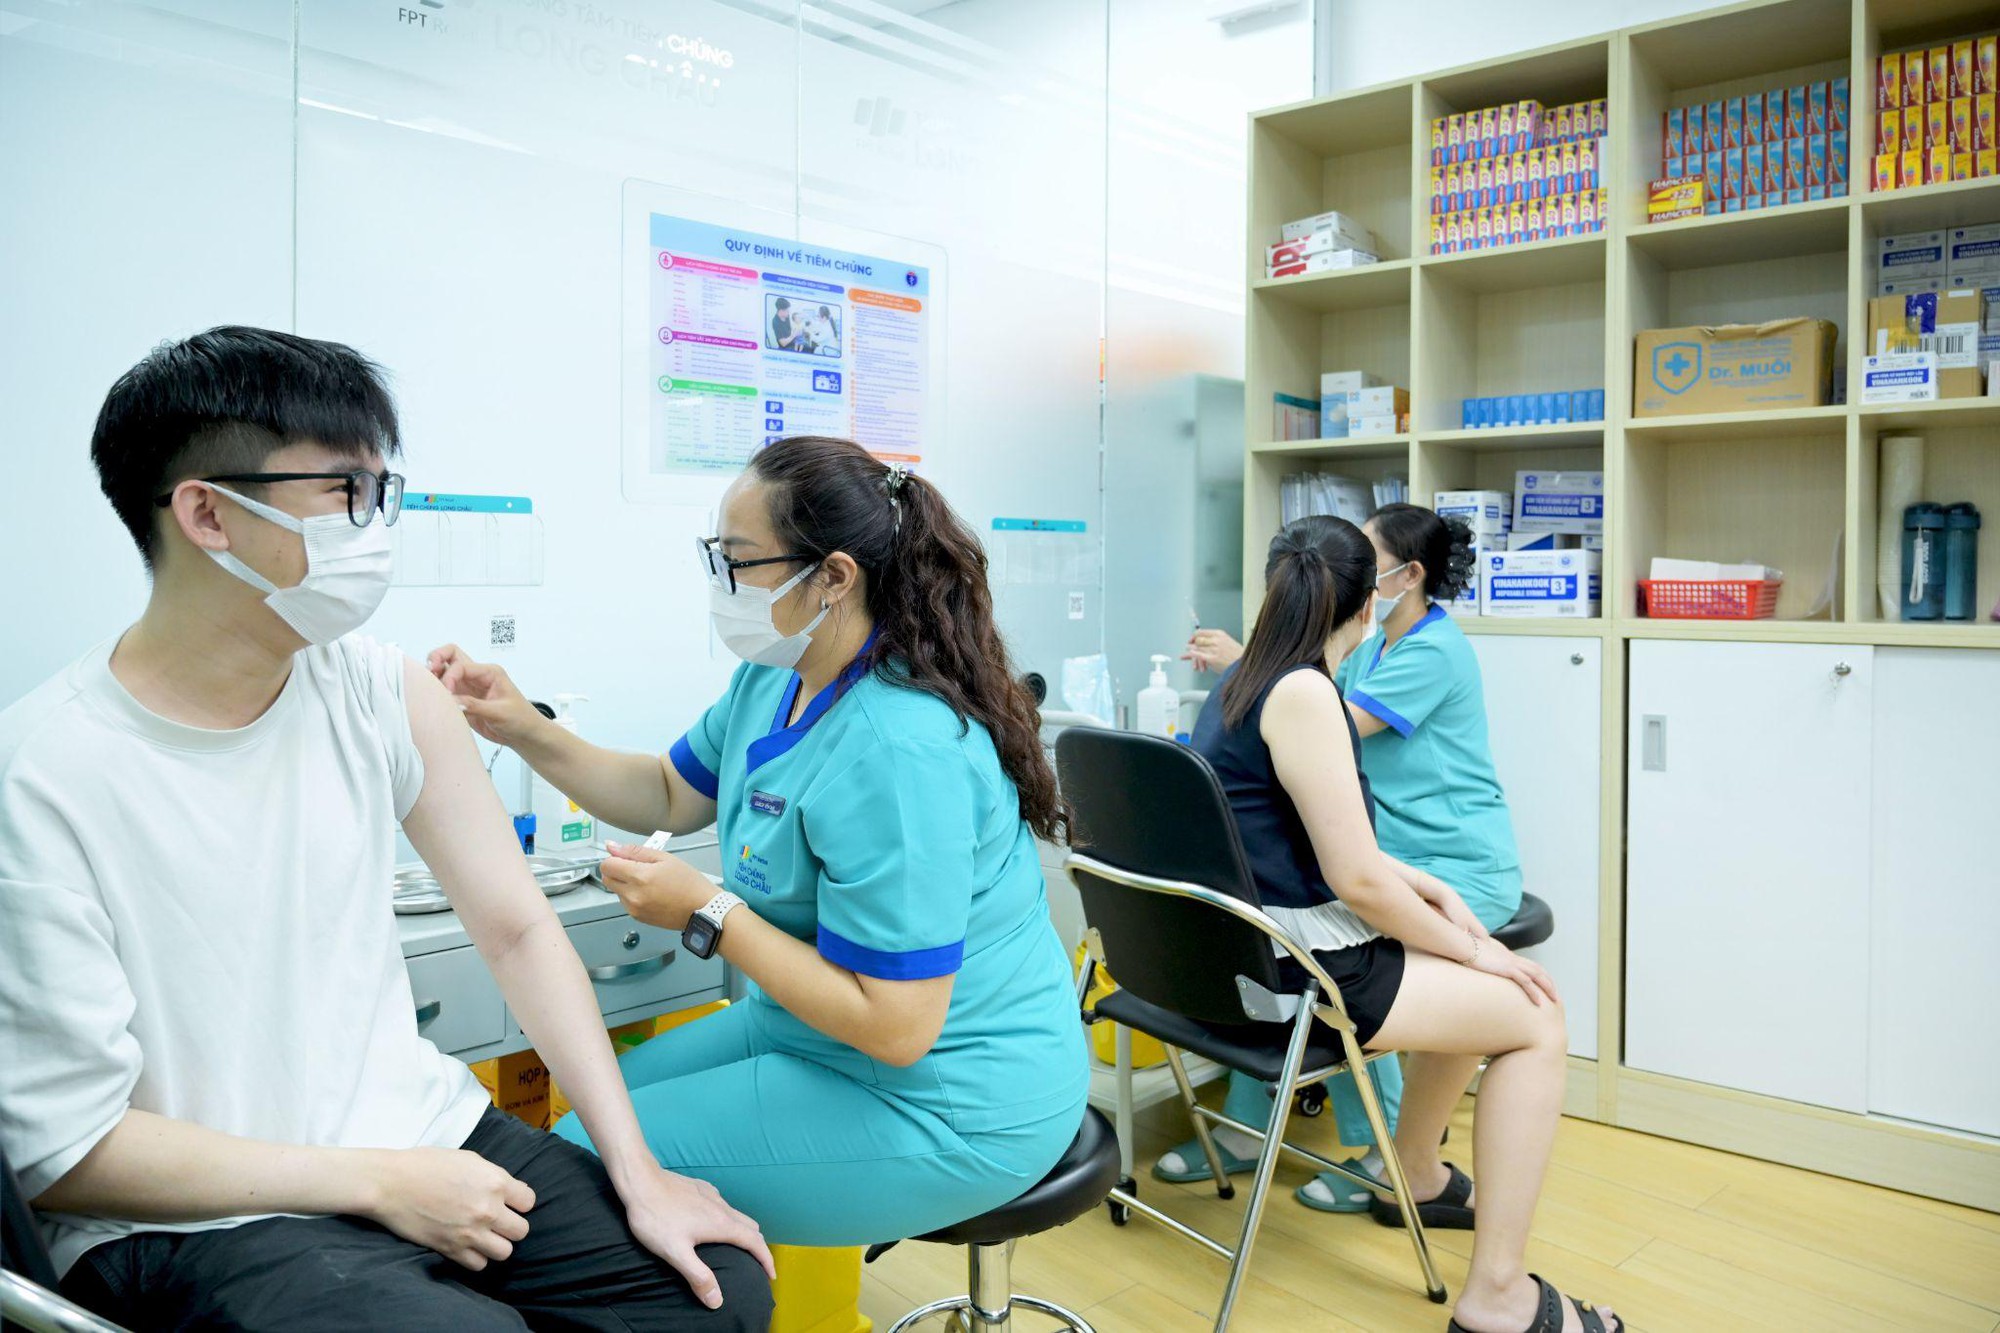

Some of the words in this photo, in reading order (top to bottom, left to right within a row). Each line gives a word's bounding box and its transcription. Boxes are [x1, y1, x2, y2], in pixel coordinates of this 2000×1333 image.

[398, 7, 428, 28] FPT
[666, 34, 735, 69] CHỦNG
[725, 239, 751, 253] QUY
[754, 244, 784, 259] ĐỊNH
[805, 254, 831, 269] TIÊM
[834, 260, 873, 276] CHỦNG
